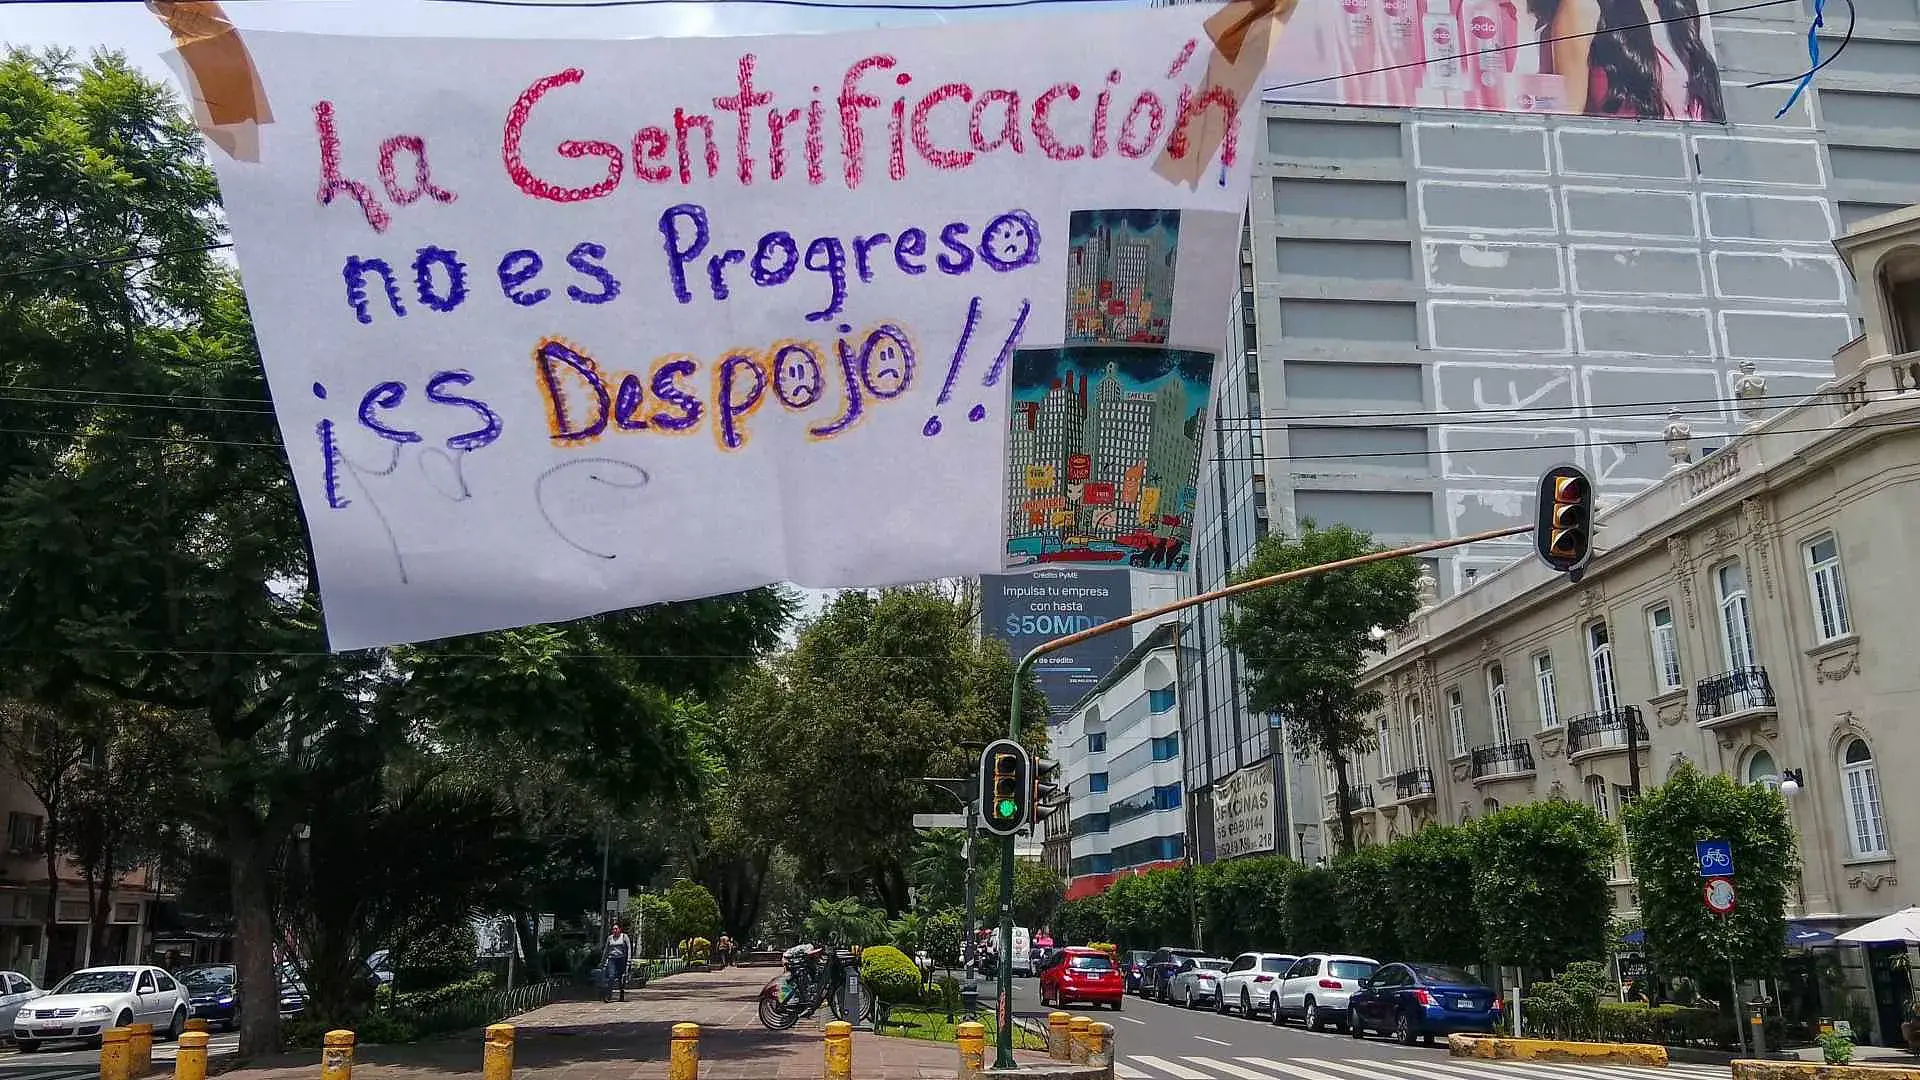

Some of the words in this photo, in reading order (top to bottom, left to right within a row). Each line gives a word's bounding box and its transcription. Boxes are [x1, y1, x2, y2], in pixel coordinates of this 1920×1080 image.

[316, 100, 458, 233] La
[502, 39, 1241, 203] Gentrificación
[343, 244, 469, 325] no
[497, 241, 621, 306] es
[658, 203, 1041, 322] Progreso
[1003, 584, 1046, 598] Impulsa
[1048, 586, 1059, 596] tu
[1062, 587, 1109, 598] empresa
[1030, 602, 1051, 611] con
[1053, 601, 1083, 611] hasta
[1049, 656, 1074, 664] crédito
[1215, 793, 1268, 821] OFICINAS
